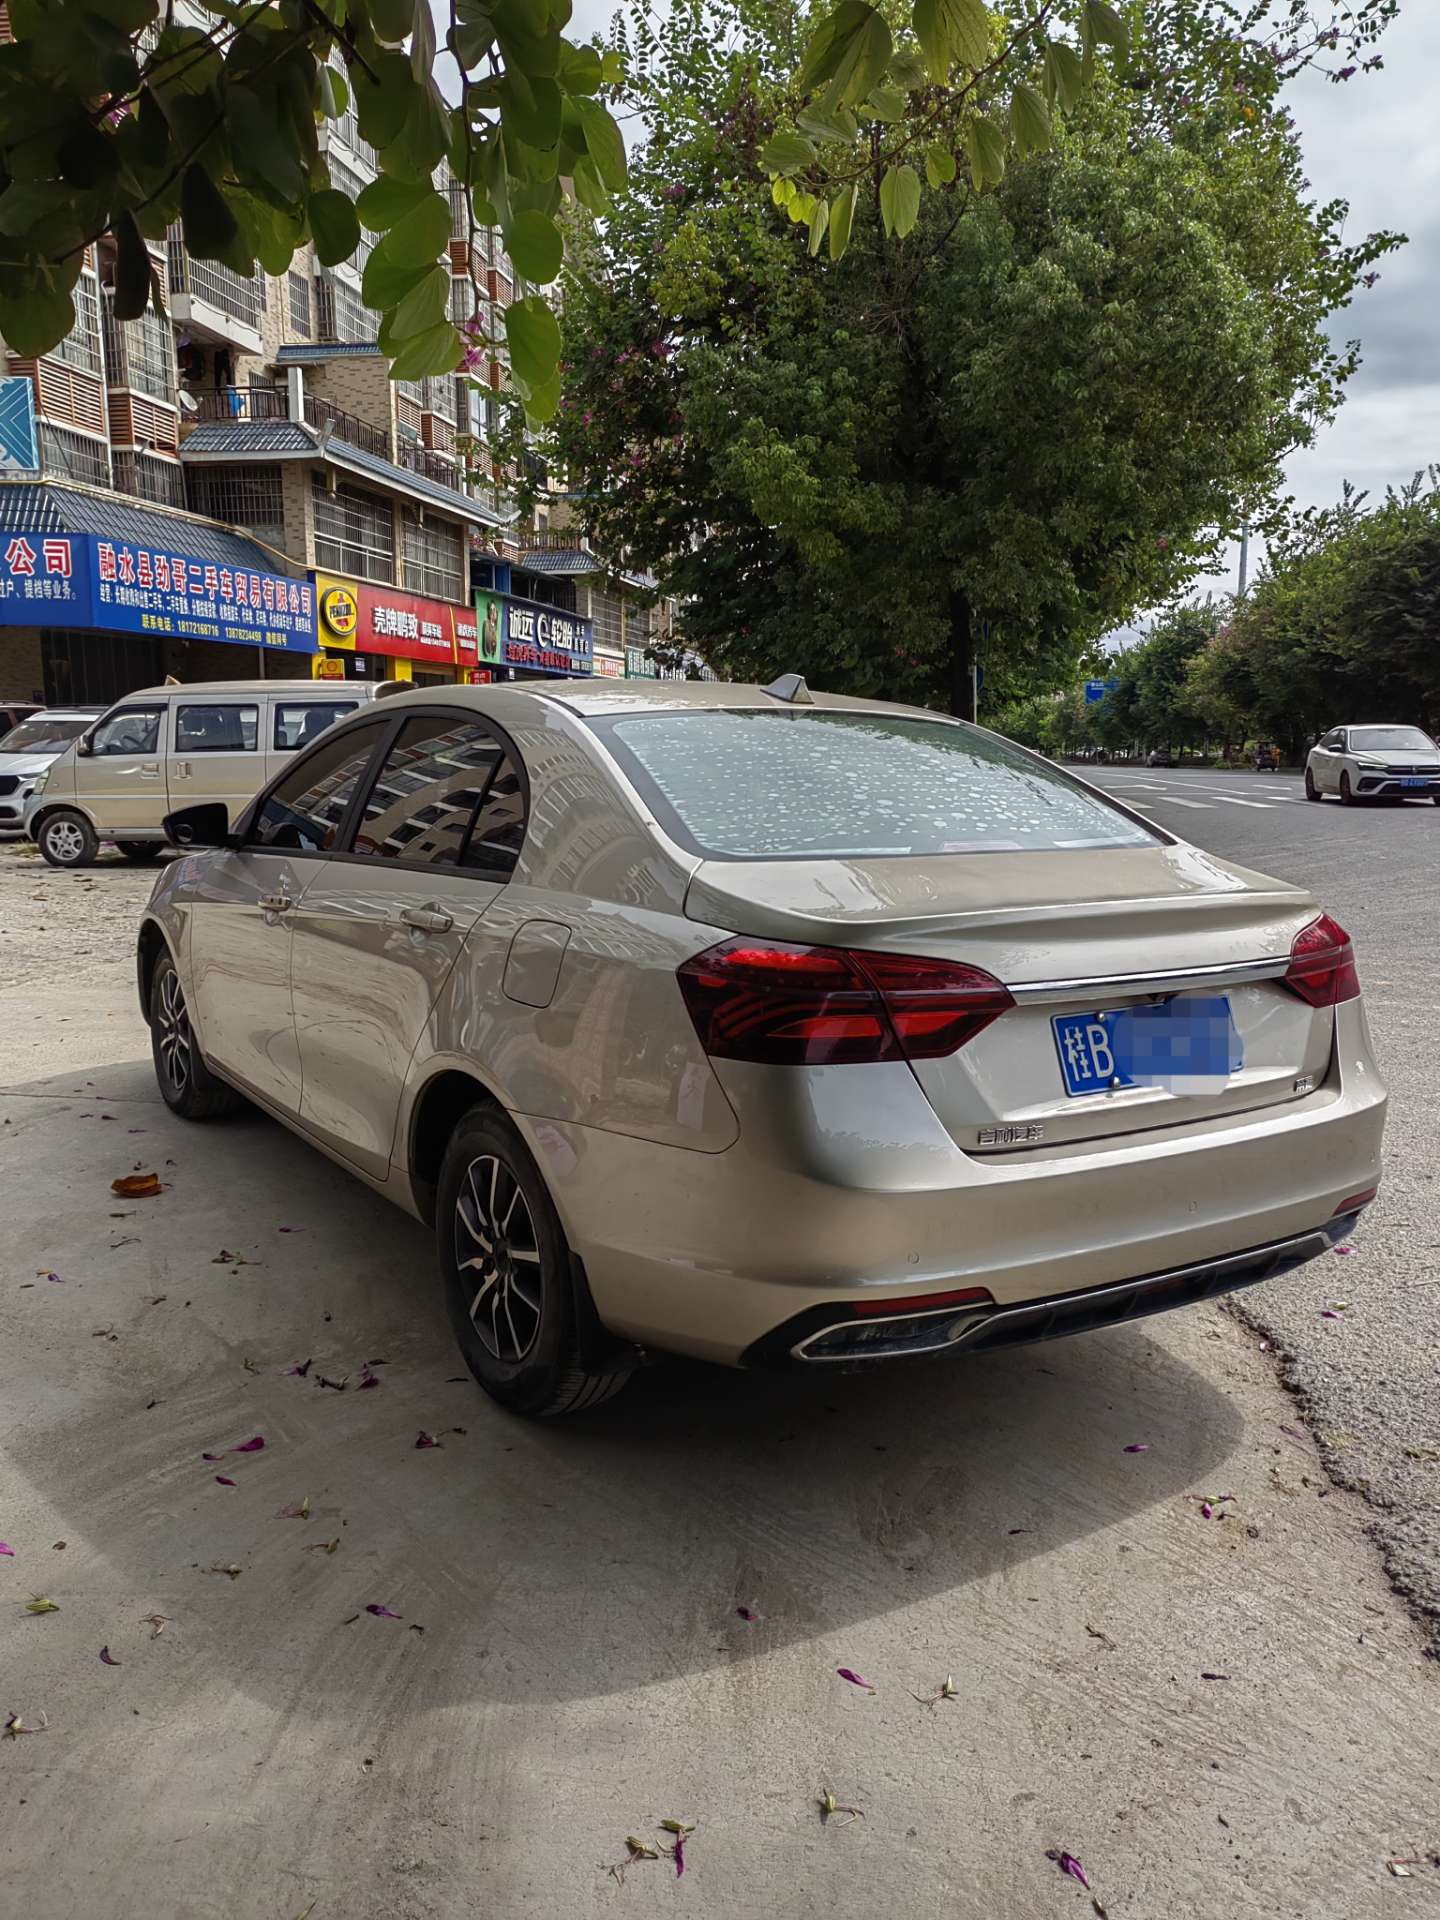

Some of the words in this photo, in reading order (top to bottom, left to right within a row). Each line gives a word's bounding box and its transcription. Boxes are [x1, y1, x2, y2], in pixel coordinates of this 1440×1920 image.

[5, 537, 72, 578] 公司
[97, 542, 312, 618] 融水县劲哥二手车贸易有限公司
[508, 605, 535, 642] 诚远
[551, 617, 573, 650] 轮胎
[978, 1123, 1043, 1145] 吉利汽车
